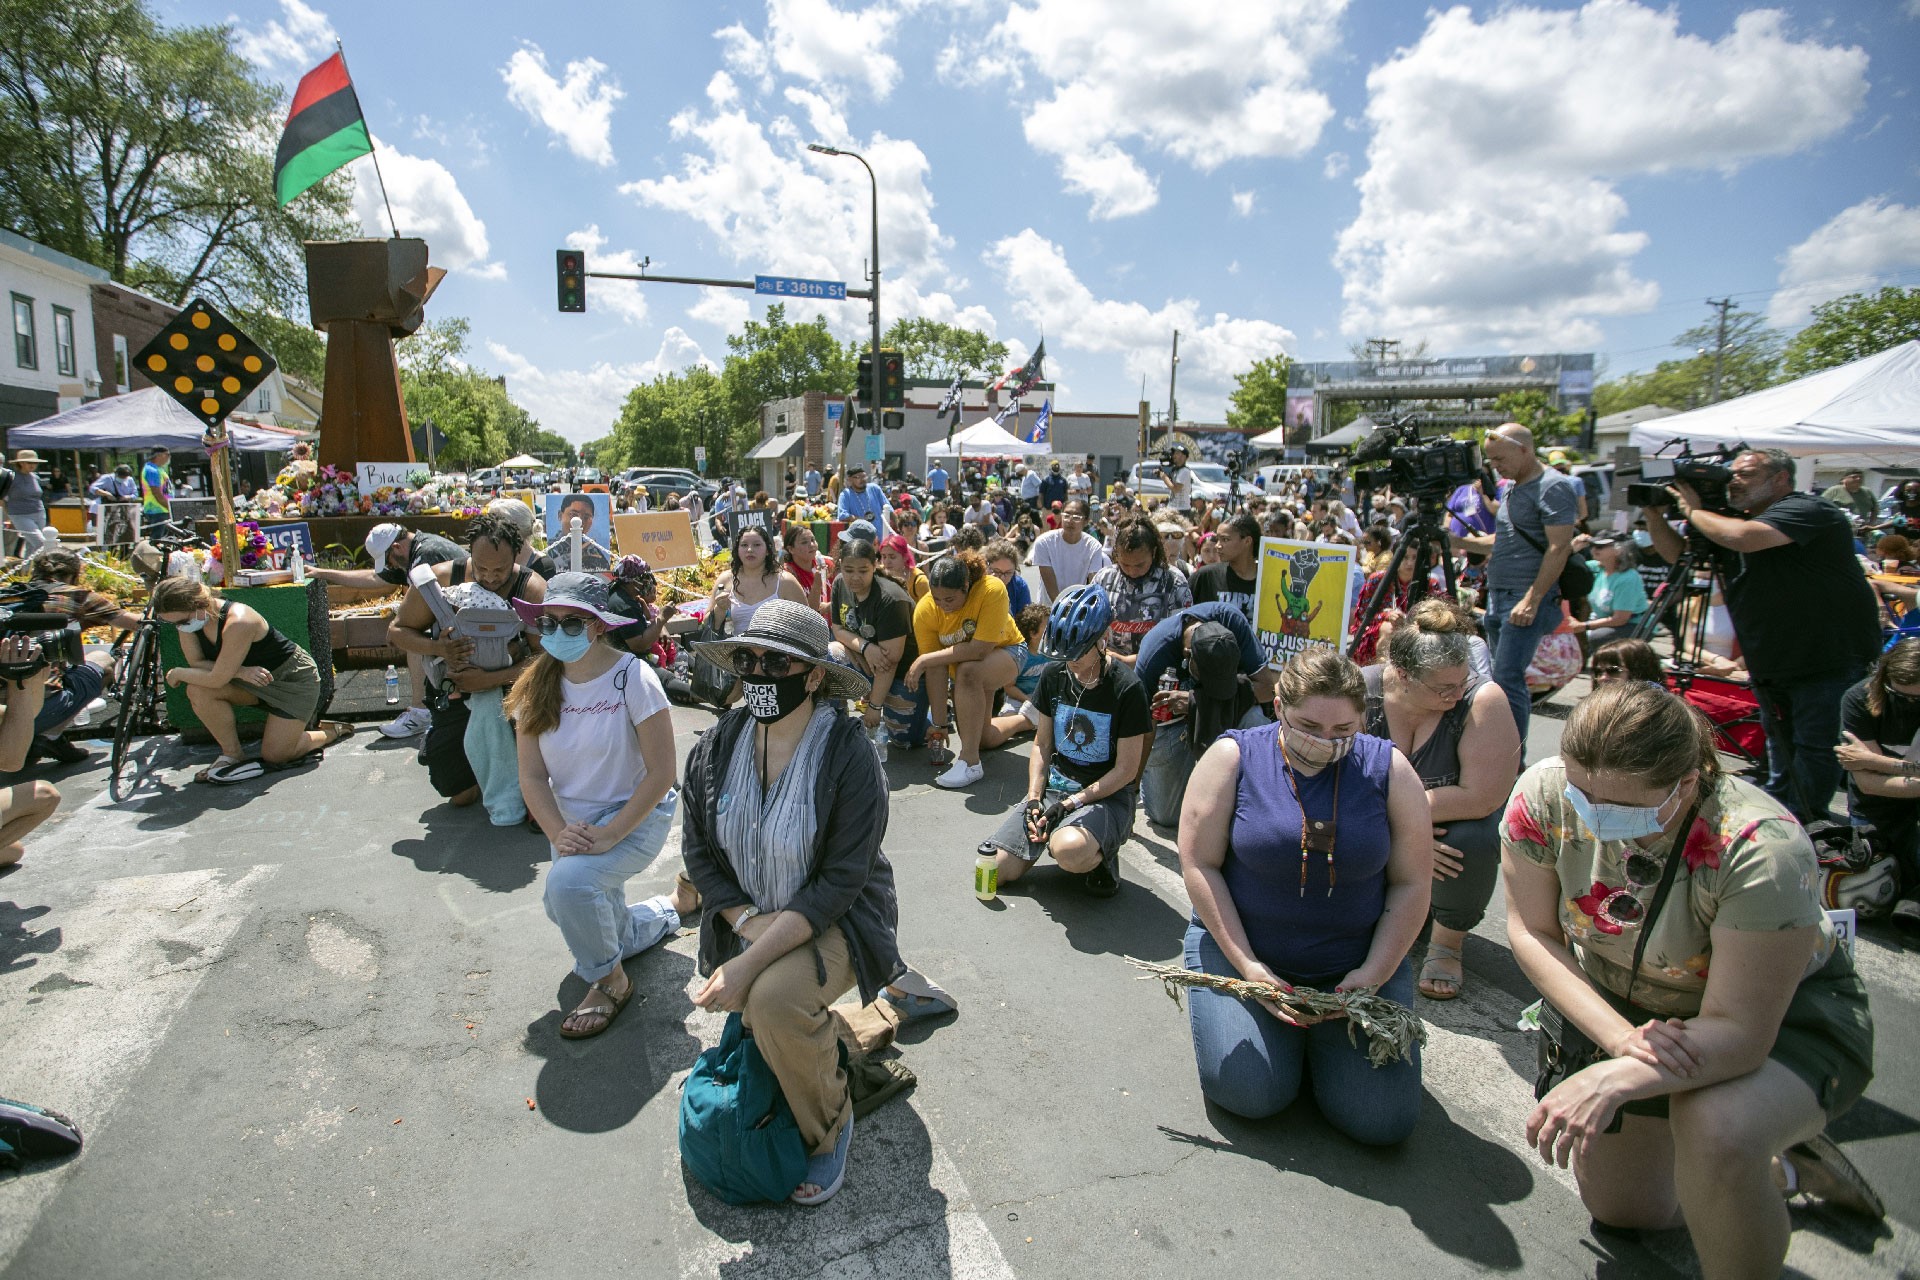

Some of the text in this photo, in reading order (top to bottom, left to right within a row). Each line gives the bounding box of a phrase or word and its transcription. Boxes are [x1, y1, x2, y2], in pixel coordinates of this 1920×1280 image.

[776, 281, 844, 297] E 38th St
[365, 464, 415, 487] Black
[737, 511, 765, 529] BLACK
[1260, 630, 1278, 647] NO
[1276, 648, 1300, 664] ST
[744, 693, 777, 706] LIVES
